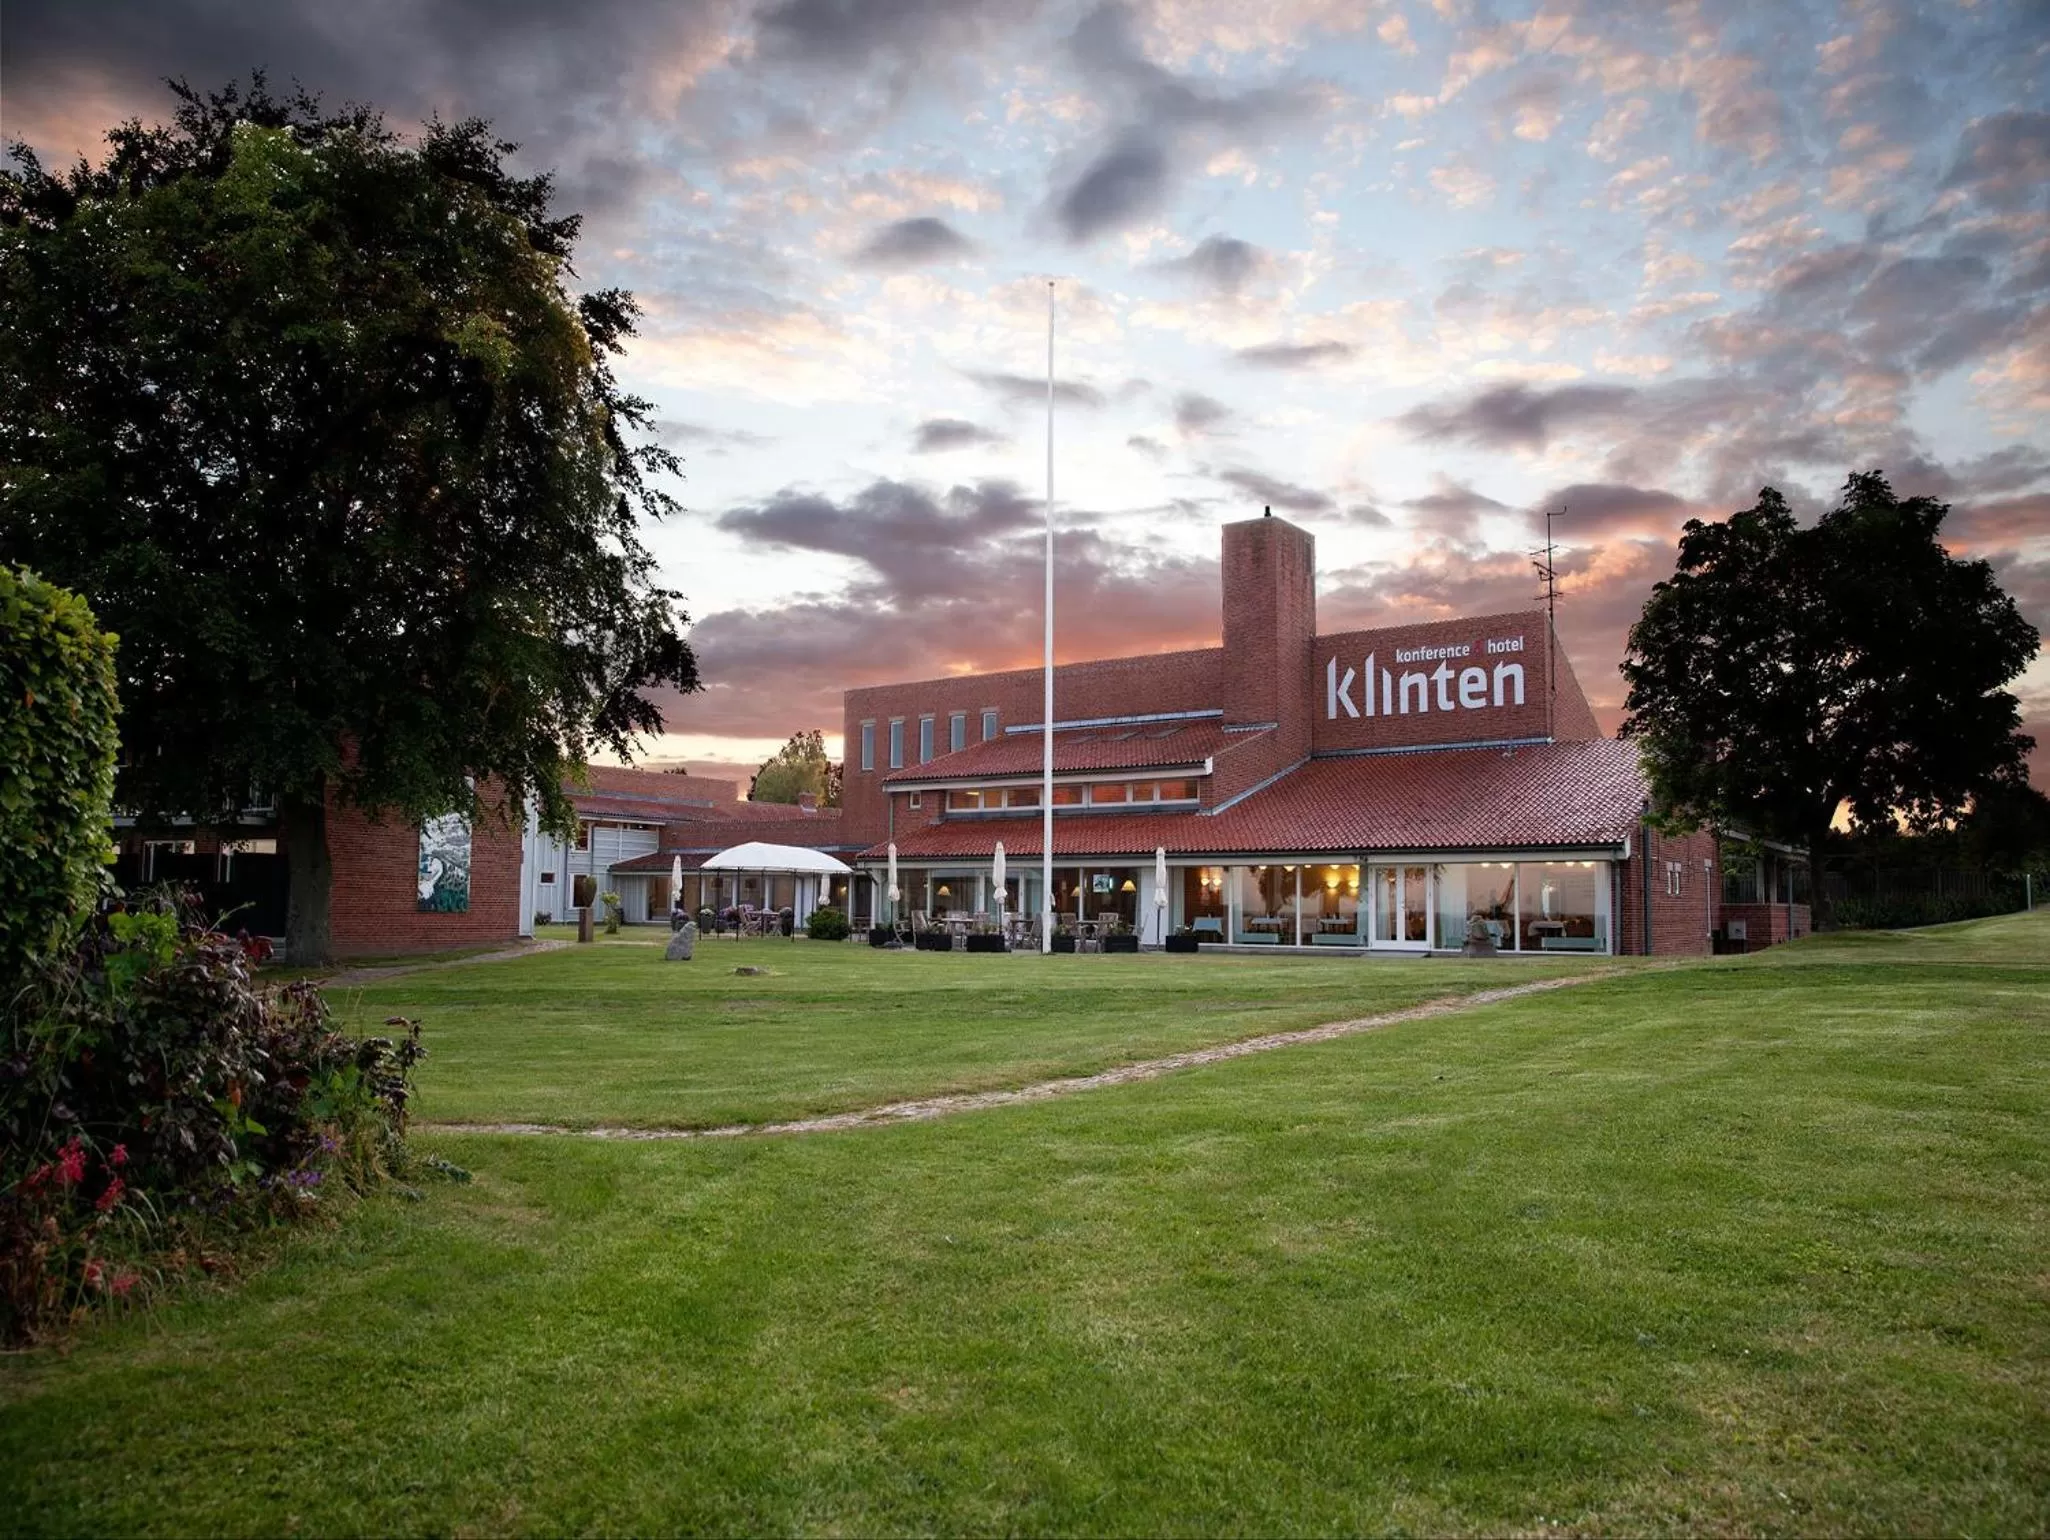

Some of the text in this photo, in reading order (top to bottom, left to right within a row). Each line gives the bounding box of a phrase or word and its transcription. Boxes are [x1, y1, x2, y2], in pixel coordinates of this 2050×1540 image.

[1396, 645, 1470, 663] konference
[1487, 635, 1524, 654] hotel
[1327, 650, 1525, 719] klinten
